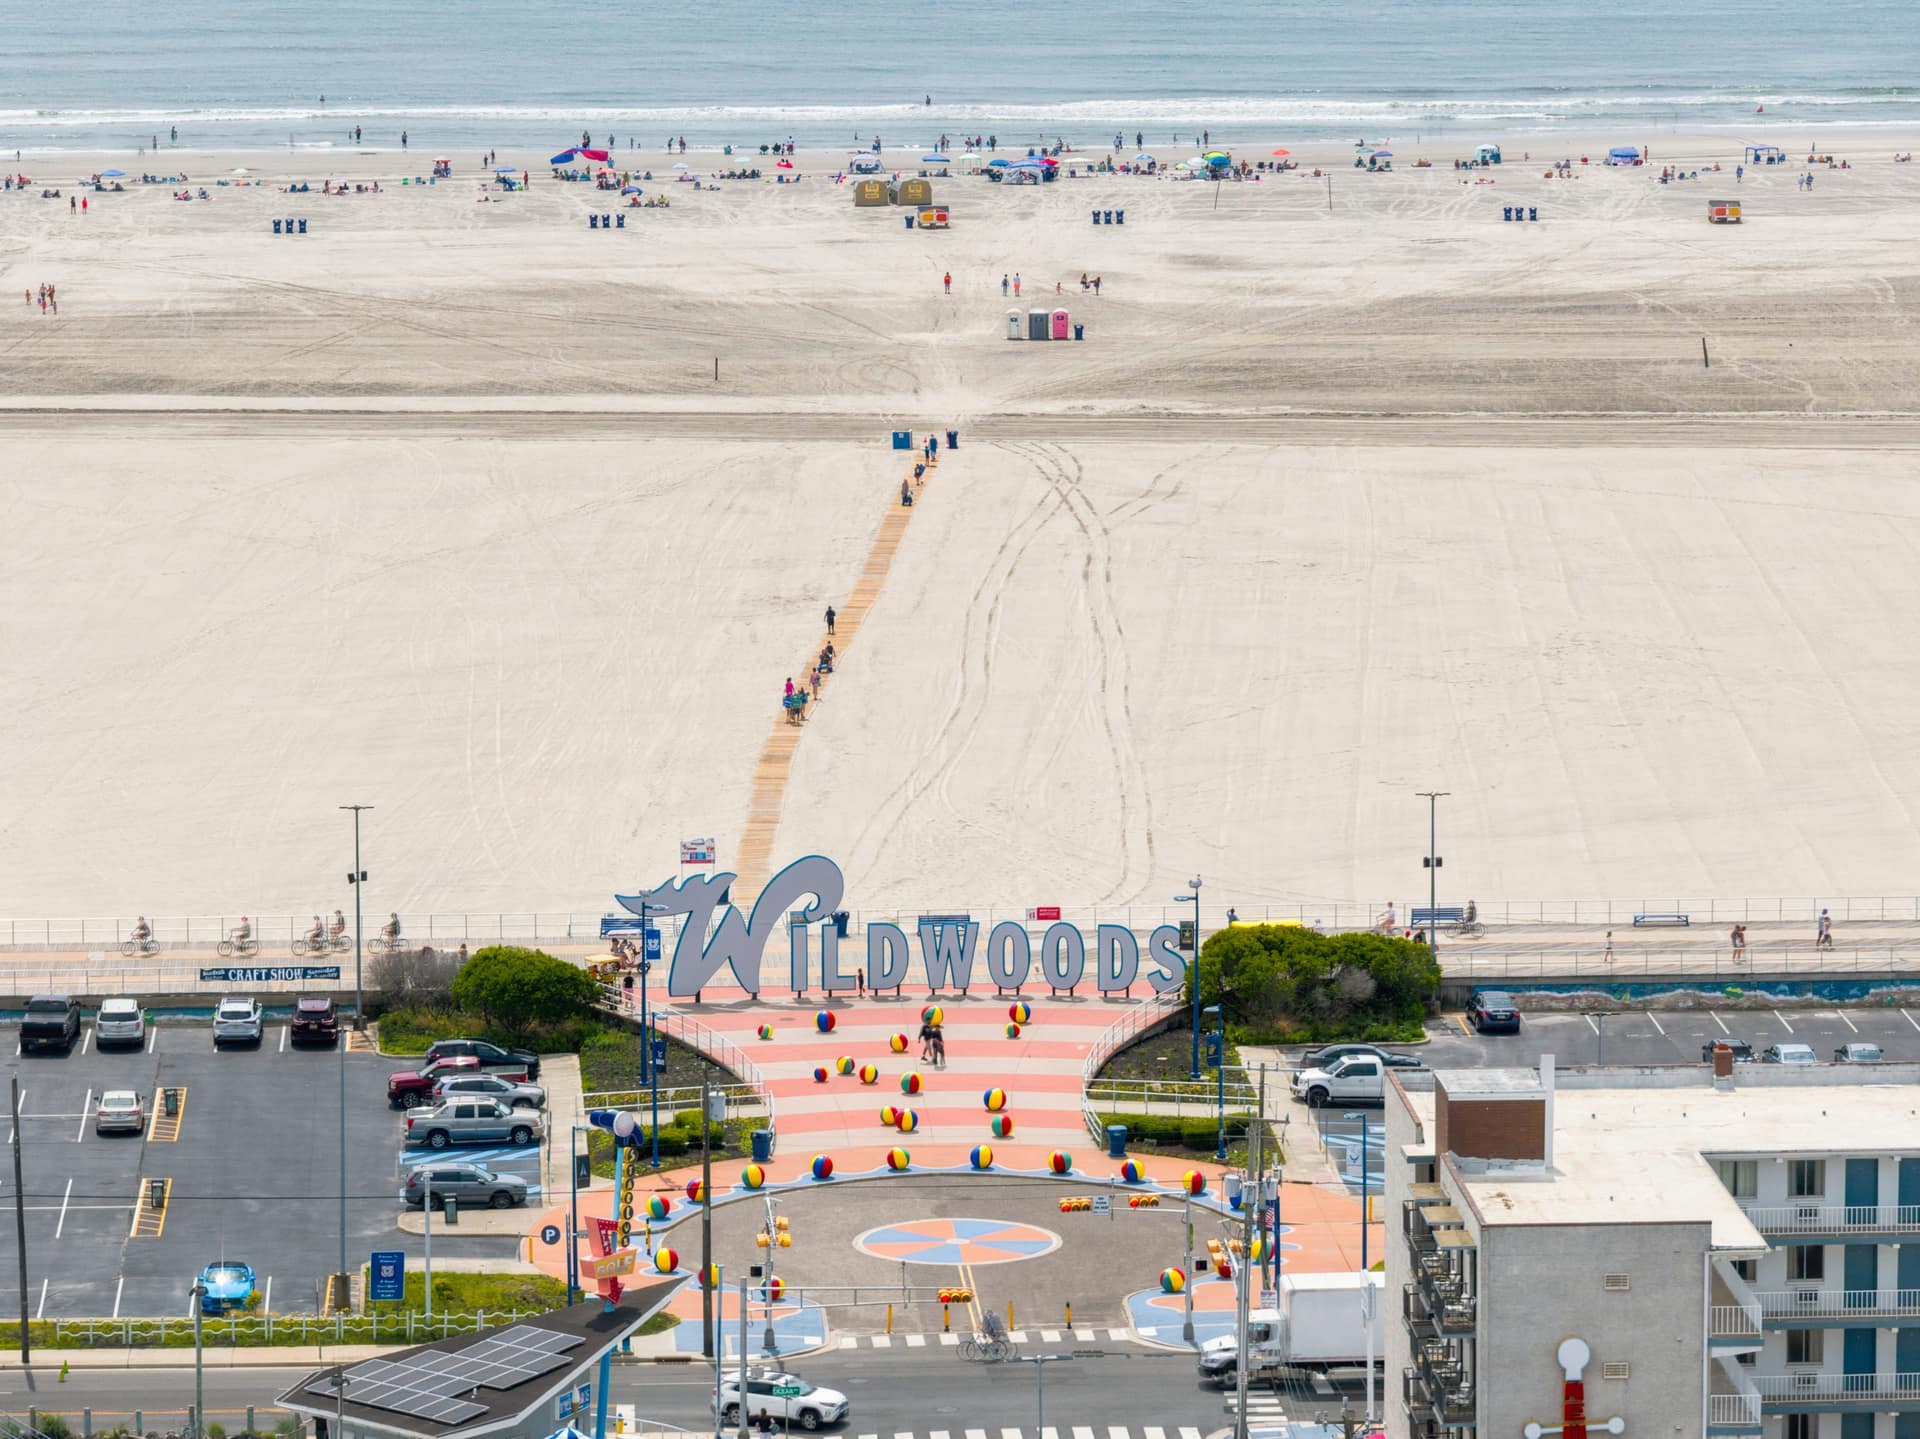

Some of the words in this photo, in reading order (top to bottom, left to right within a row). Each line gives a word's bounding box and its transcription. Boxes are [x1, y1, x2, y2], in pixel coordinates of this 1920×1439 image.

[228, 969, 268, 981] CRAFT
[270, 968, 303, 980] SHOW
[545, 1229, 556, 1242] P
[597, 1255, 633, 1276] GOLF
